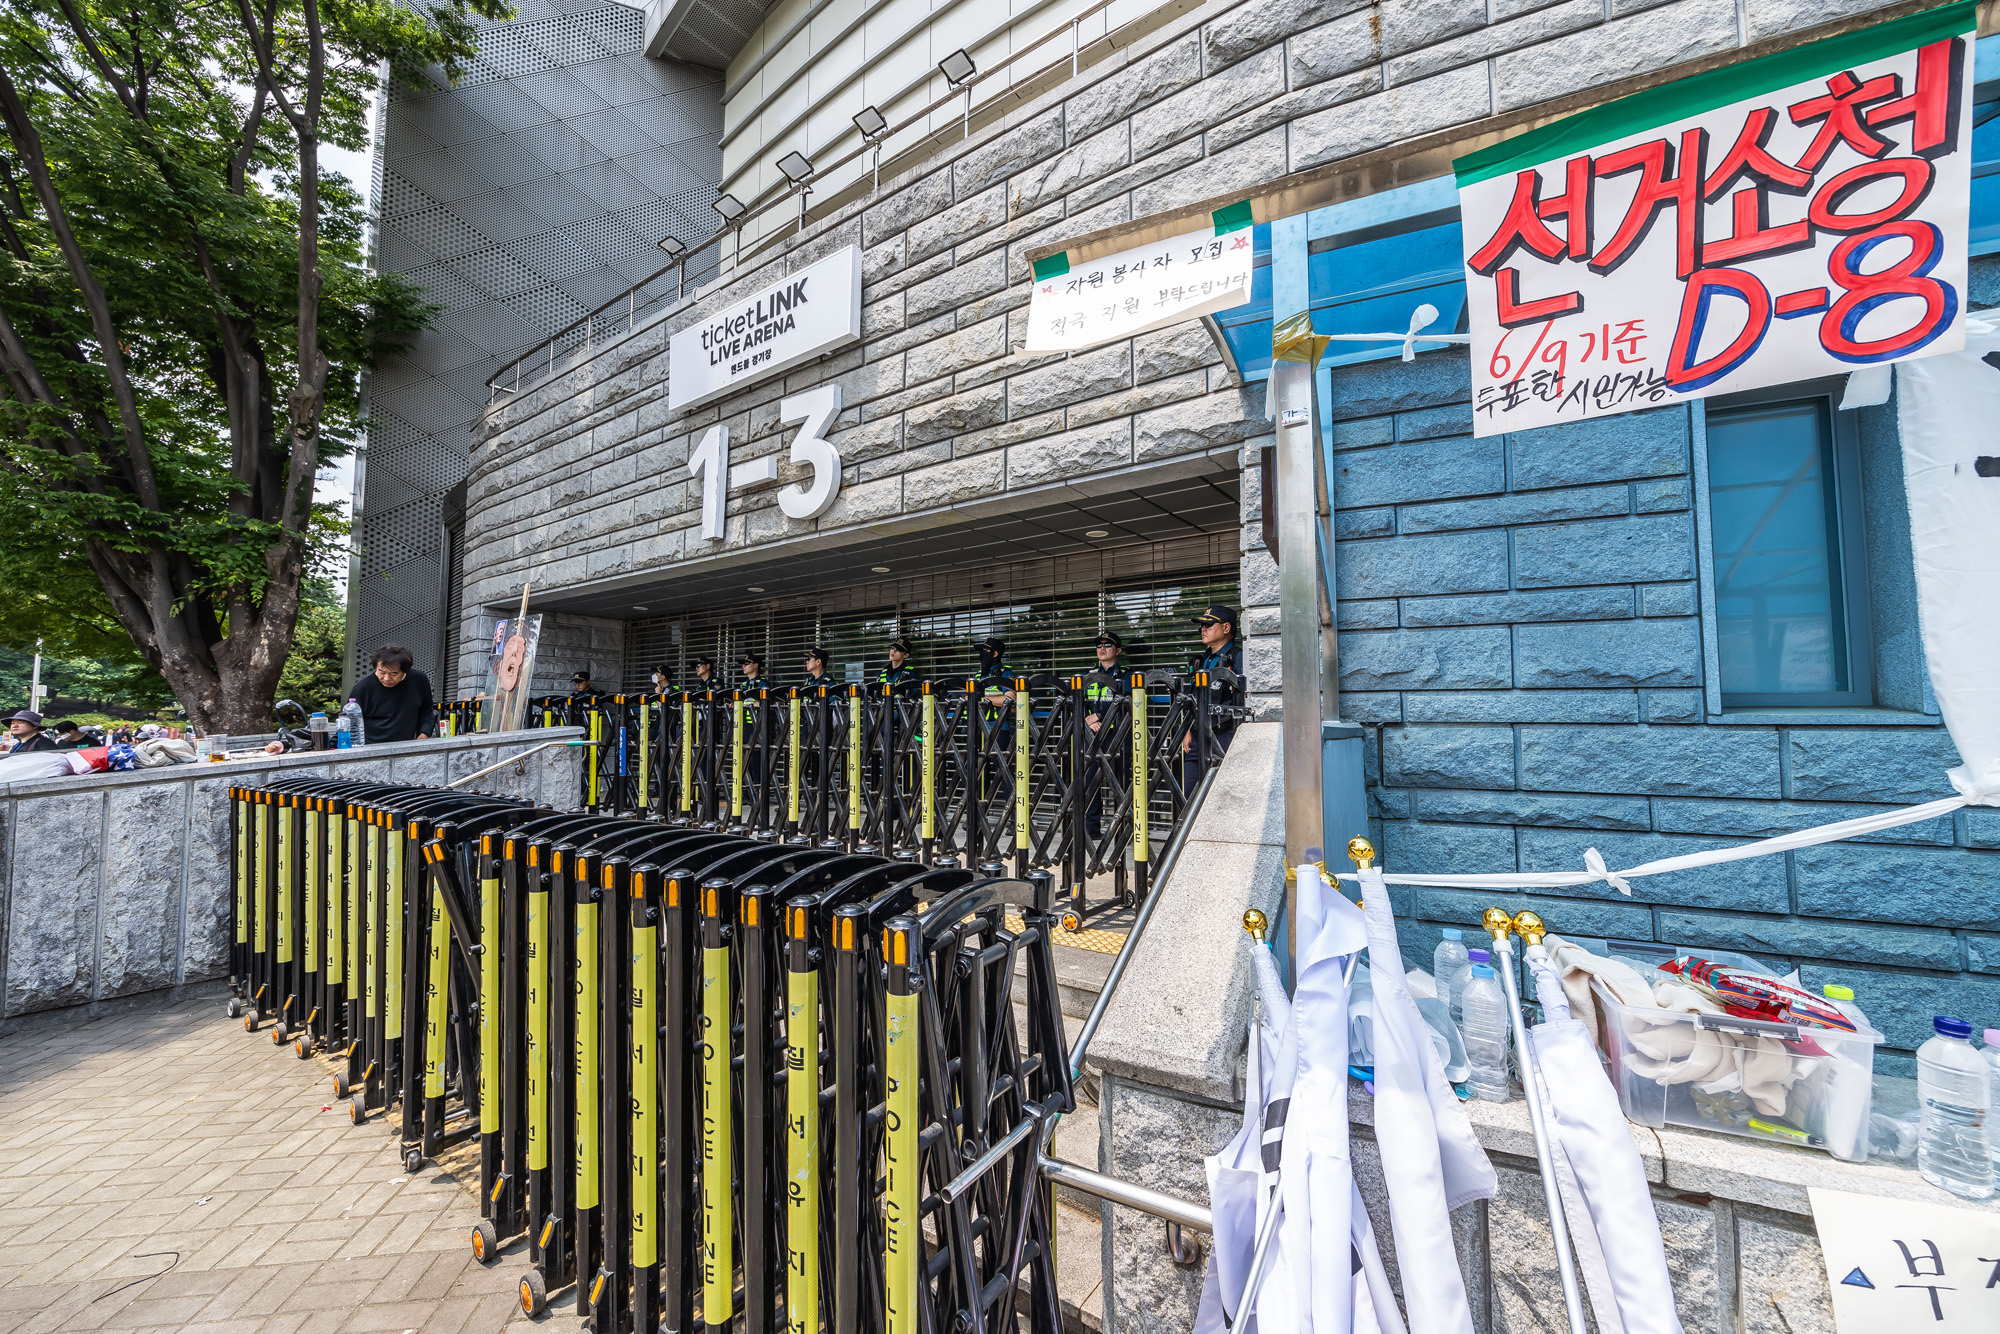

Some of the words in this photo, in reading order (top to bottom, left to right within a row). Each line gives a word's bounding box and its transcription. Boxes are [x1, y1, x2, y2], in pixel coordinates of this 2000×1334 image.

[1467, 36, 1965, 328] 선거소청
[1050, 312, 1088, 336] 적극
[1102, 296, 1139, 324] 지원
[1153, 272, 1249, 307] 부탁드립니다
[1066, 271, 1104, 295] 자원
[1187, 241, 1222, 265] 모집
[1664, 220, 1959, 393] D-8
[701, 277, 809, 350] ticketLINK
[710, 338, 741, 366] LIVE
[743, 314, 796, 351] ARENA
[730, 360, 750, 375] 핸드볼
[751, 349, 772, 366] 경기장
[1489, 319, 1567, 398] 6/9
[1579, 319, 1647, 364] 기준
[688, 384, 842, 541] 1-3
[1017, 720, 1025, 833] 질서유지선
[1134, 719, 1142, 786] POLICE
[703, 1016, 715, 1160] POLICE
[886, 1076, 901, 1254] POLICE
[704, 1188, 715, 1285] LINE
